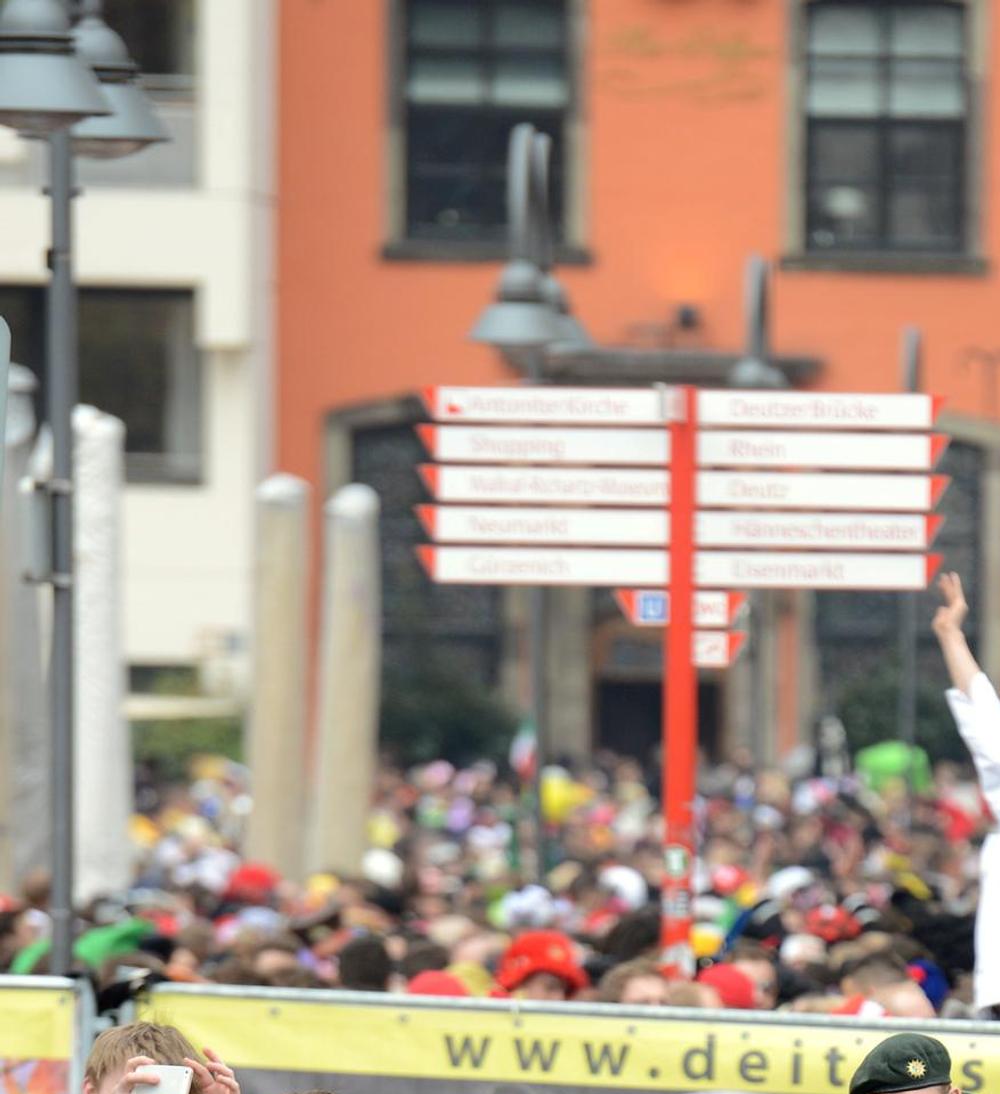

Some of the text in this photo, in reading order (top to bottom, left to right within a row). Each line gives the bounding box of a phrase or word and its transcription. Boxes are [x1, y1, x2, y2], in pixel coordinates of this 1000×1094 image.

[470, 435, 566, 459] Shopping
[729, 438, 786, 457] Rhein
[469, 515, 568, 535] Neumarkt
